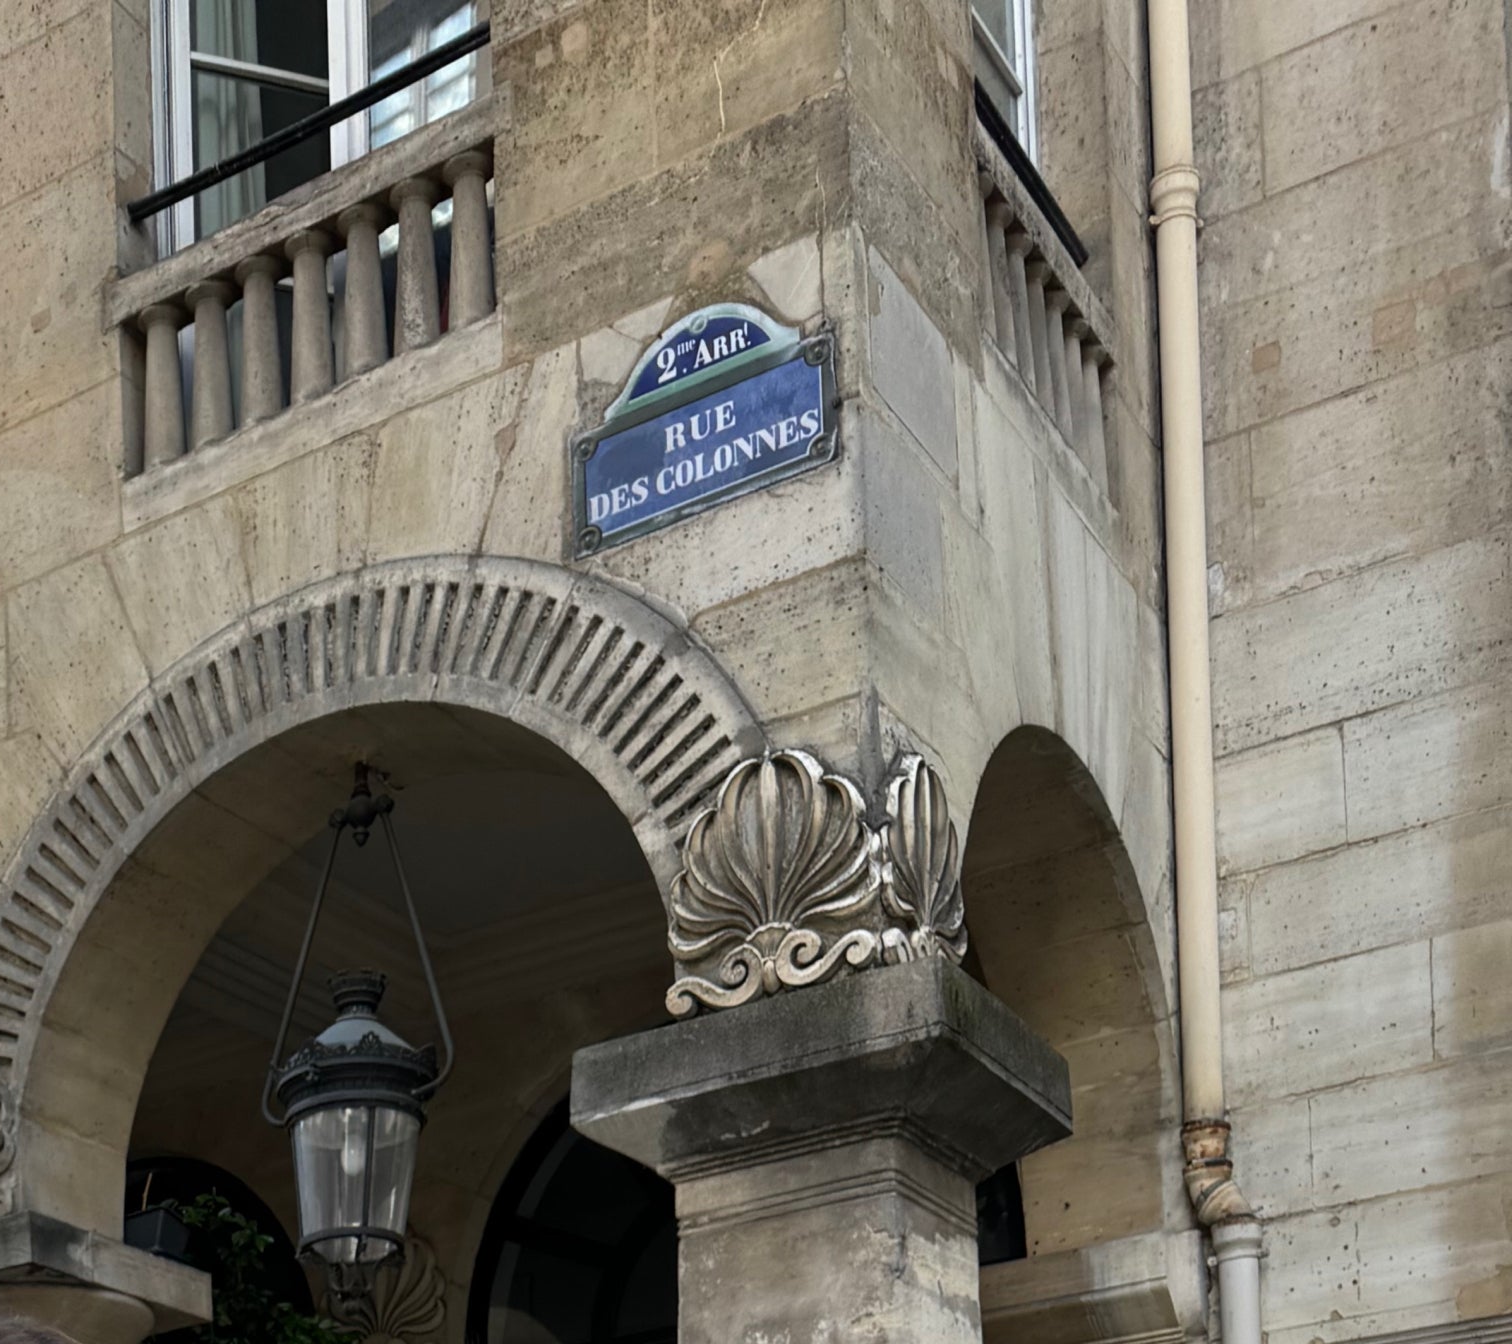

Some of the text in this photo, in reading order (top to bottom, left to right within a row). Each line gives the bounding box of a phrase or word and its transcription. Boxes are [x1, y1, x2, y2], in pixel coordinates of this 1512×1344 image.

[589, 409, 820, 523] DES COLONNES
[664, 400, 737, 454] RUE
